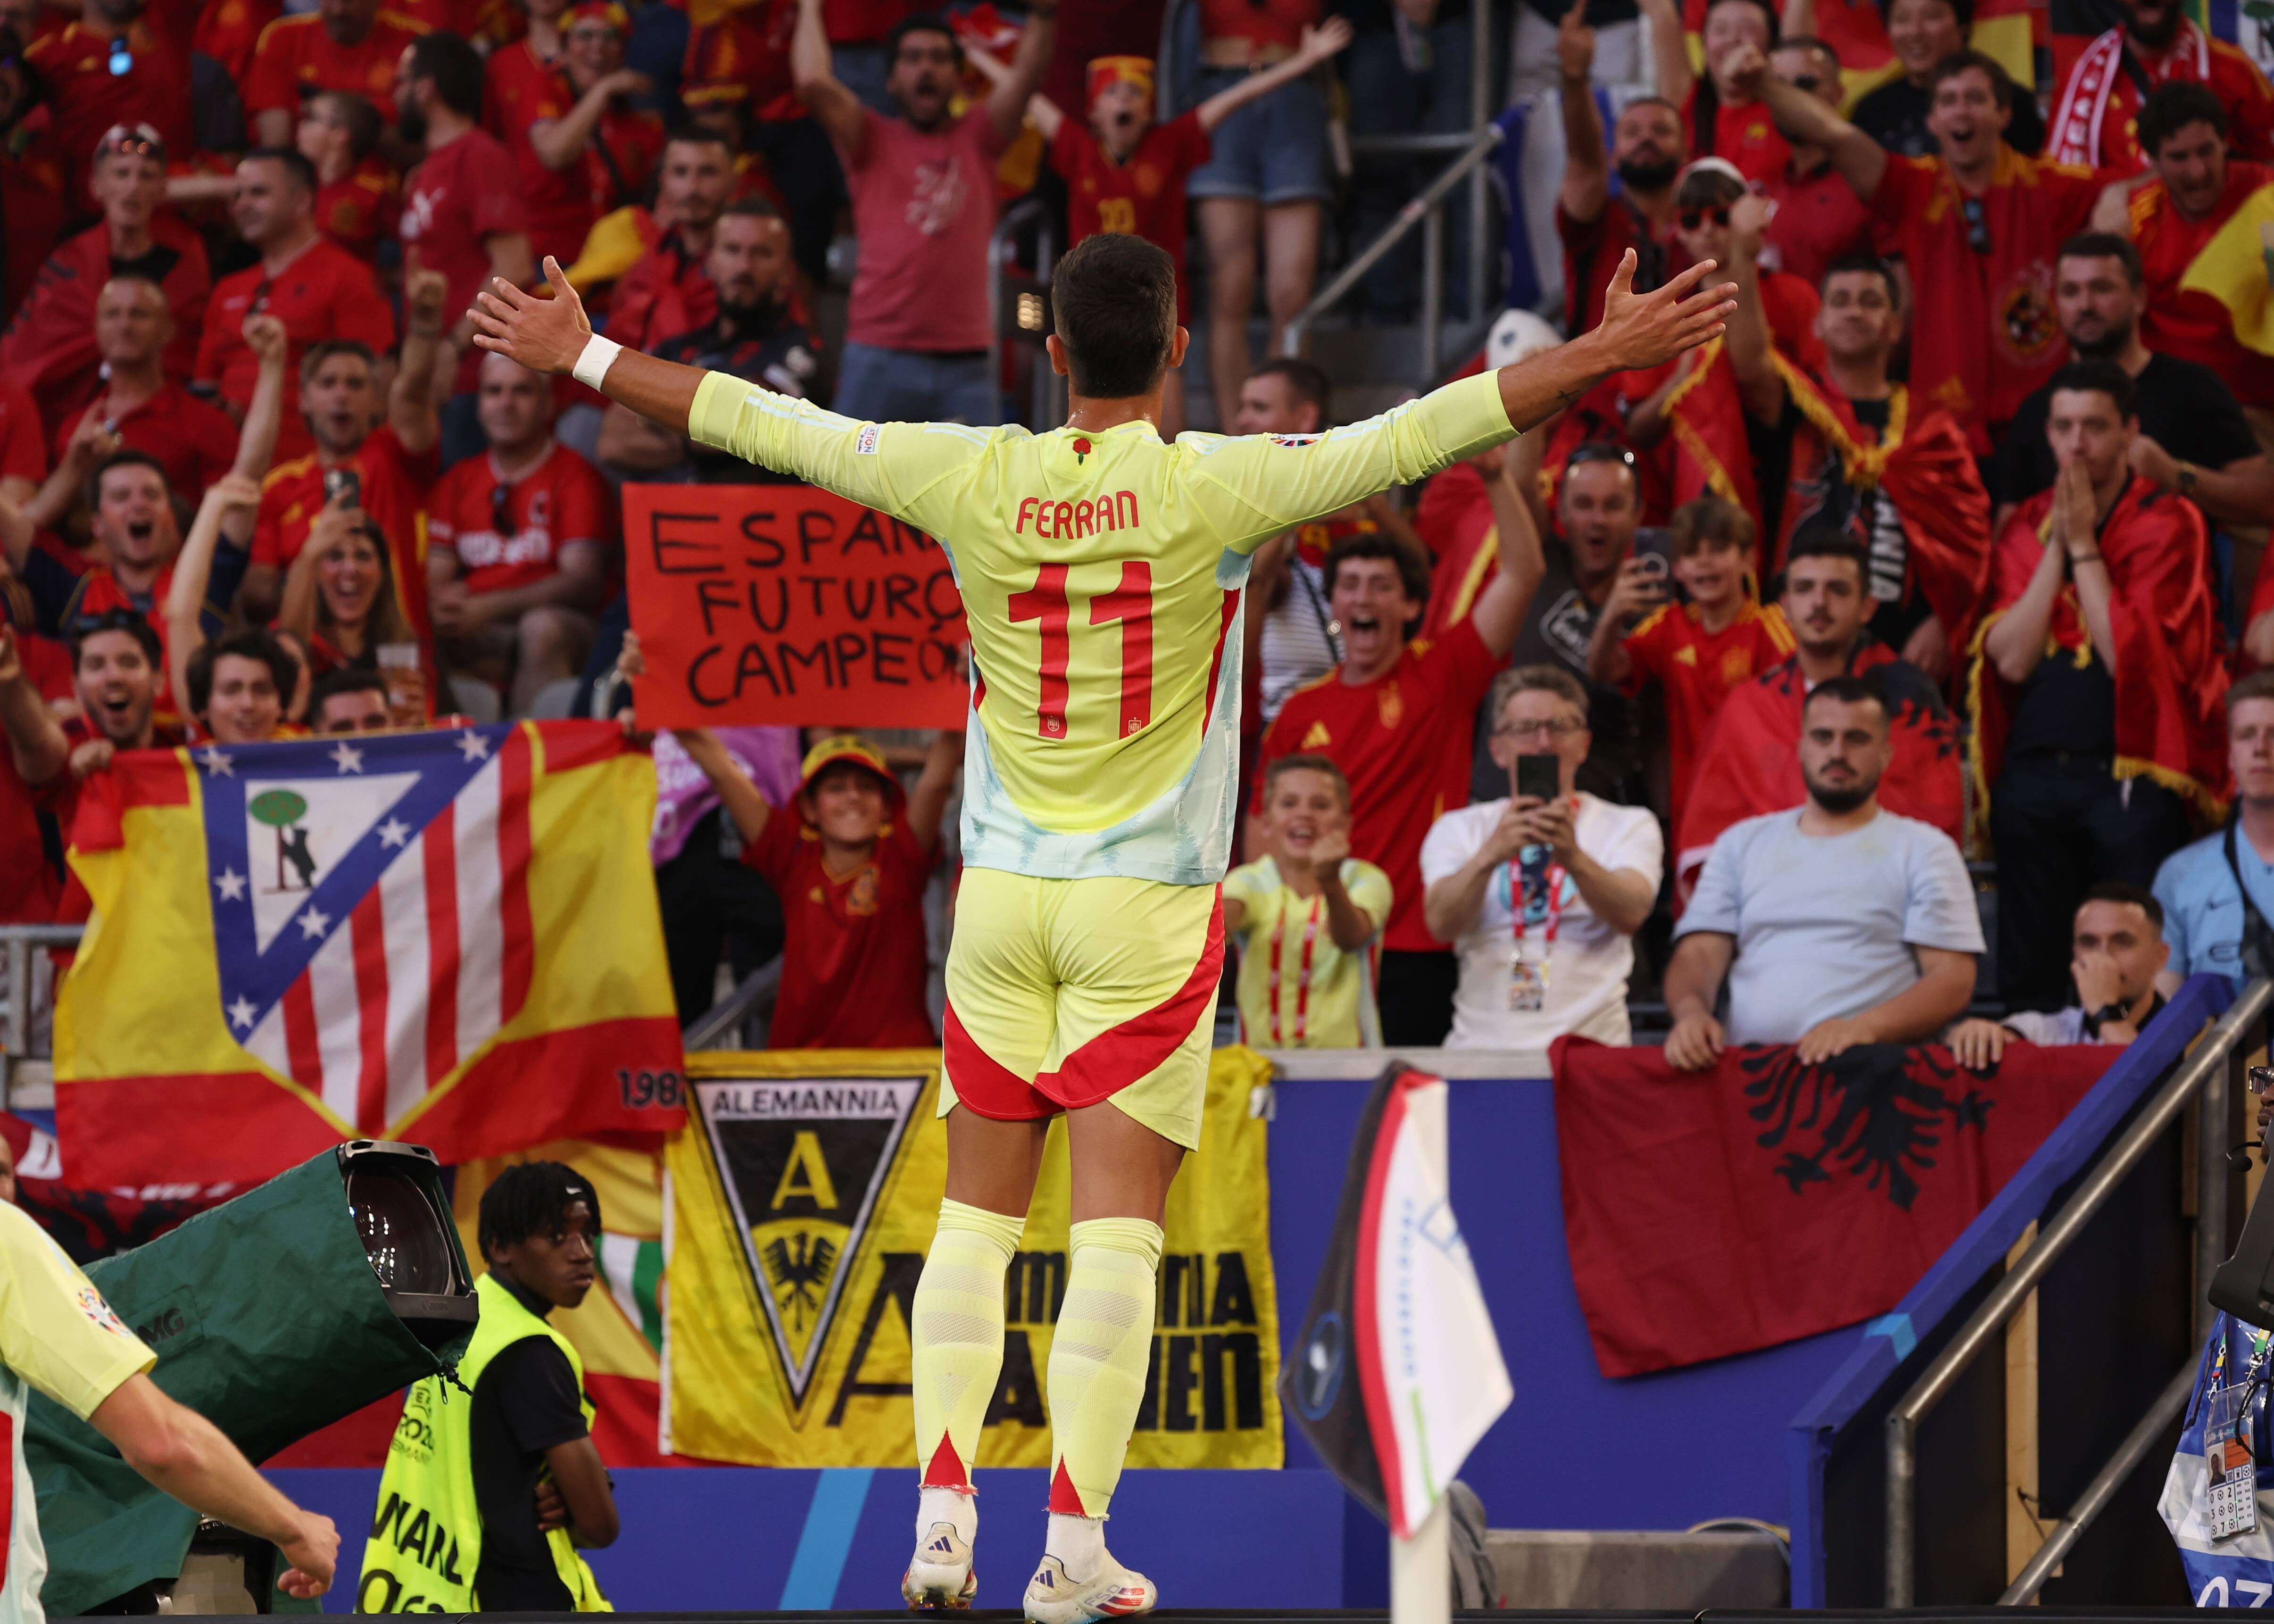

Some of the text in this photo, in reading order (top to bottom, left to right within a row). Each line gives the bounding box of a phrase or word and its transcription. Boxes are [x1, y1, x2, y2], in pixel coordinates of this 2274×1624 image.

[1016, 490, 1139, 539] FERRAN
[698, 570, 963, 636] FUTURO
[1007, 561, 1153, 740] 11
[618, 1069, 686, 1106] 198
[713, 1088, 898, 1114] ALEMANNIA
[770, 1130, 840, 1210] A
